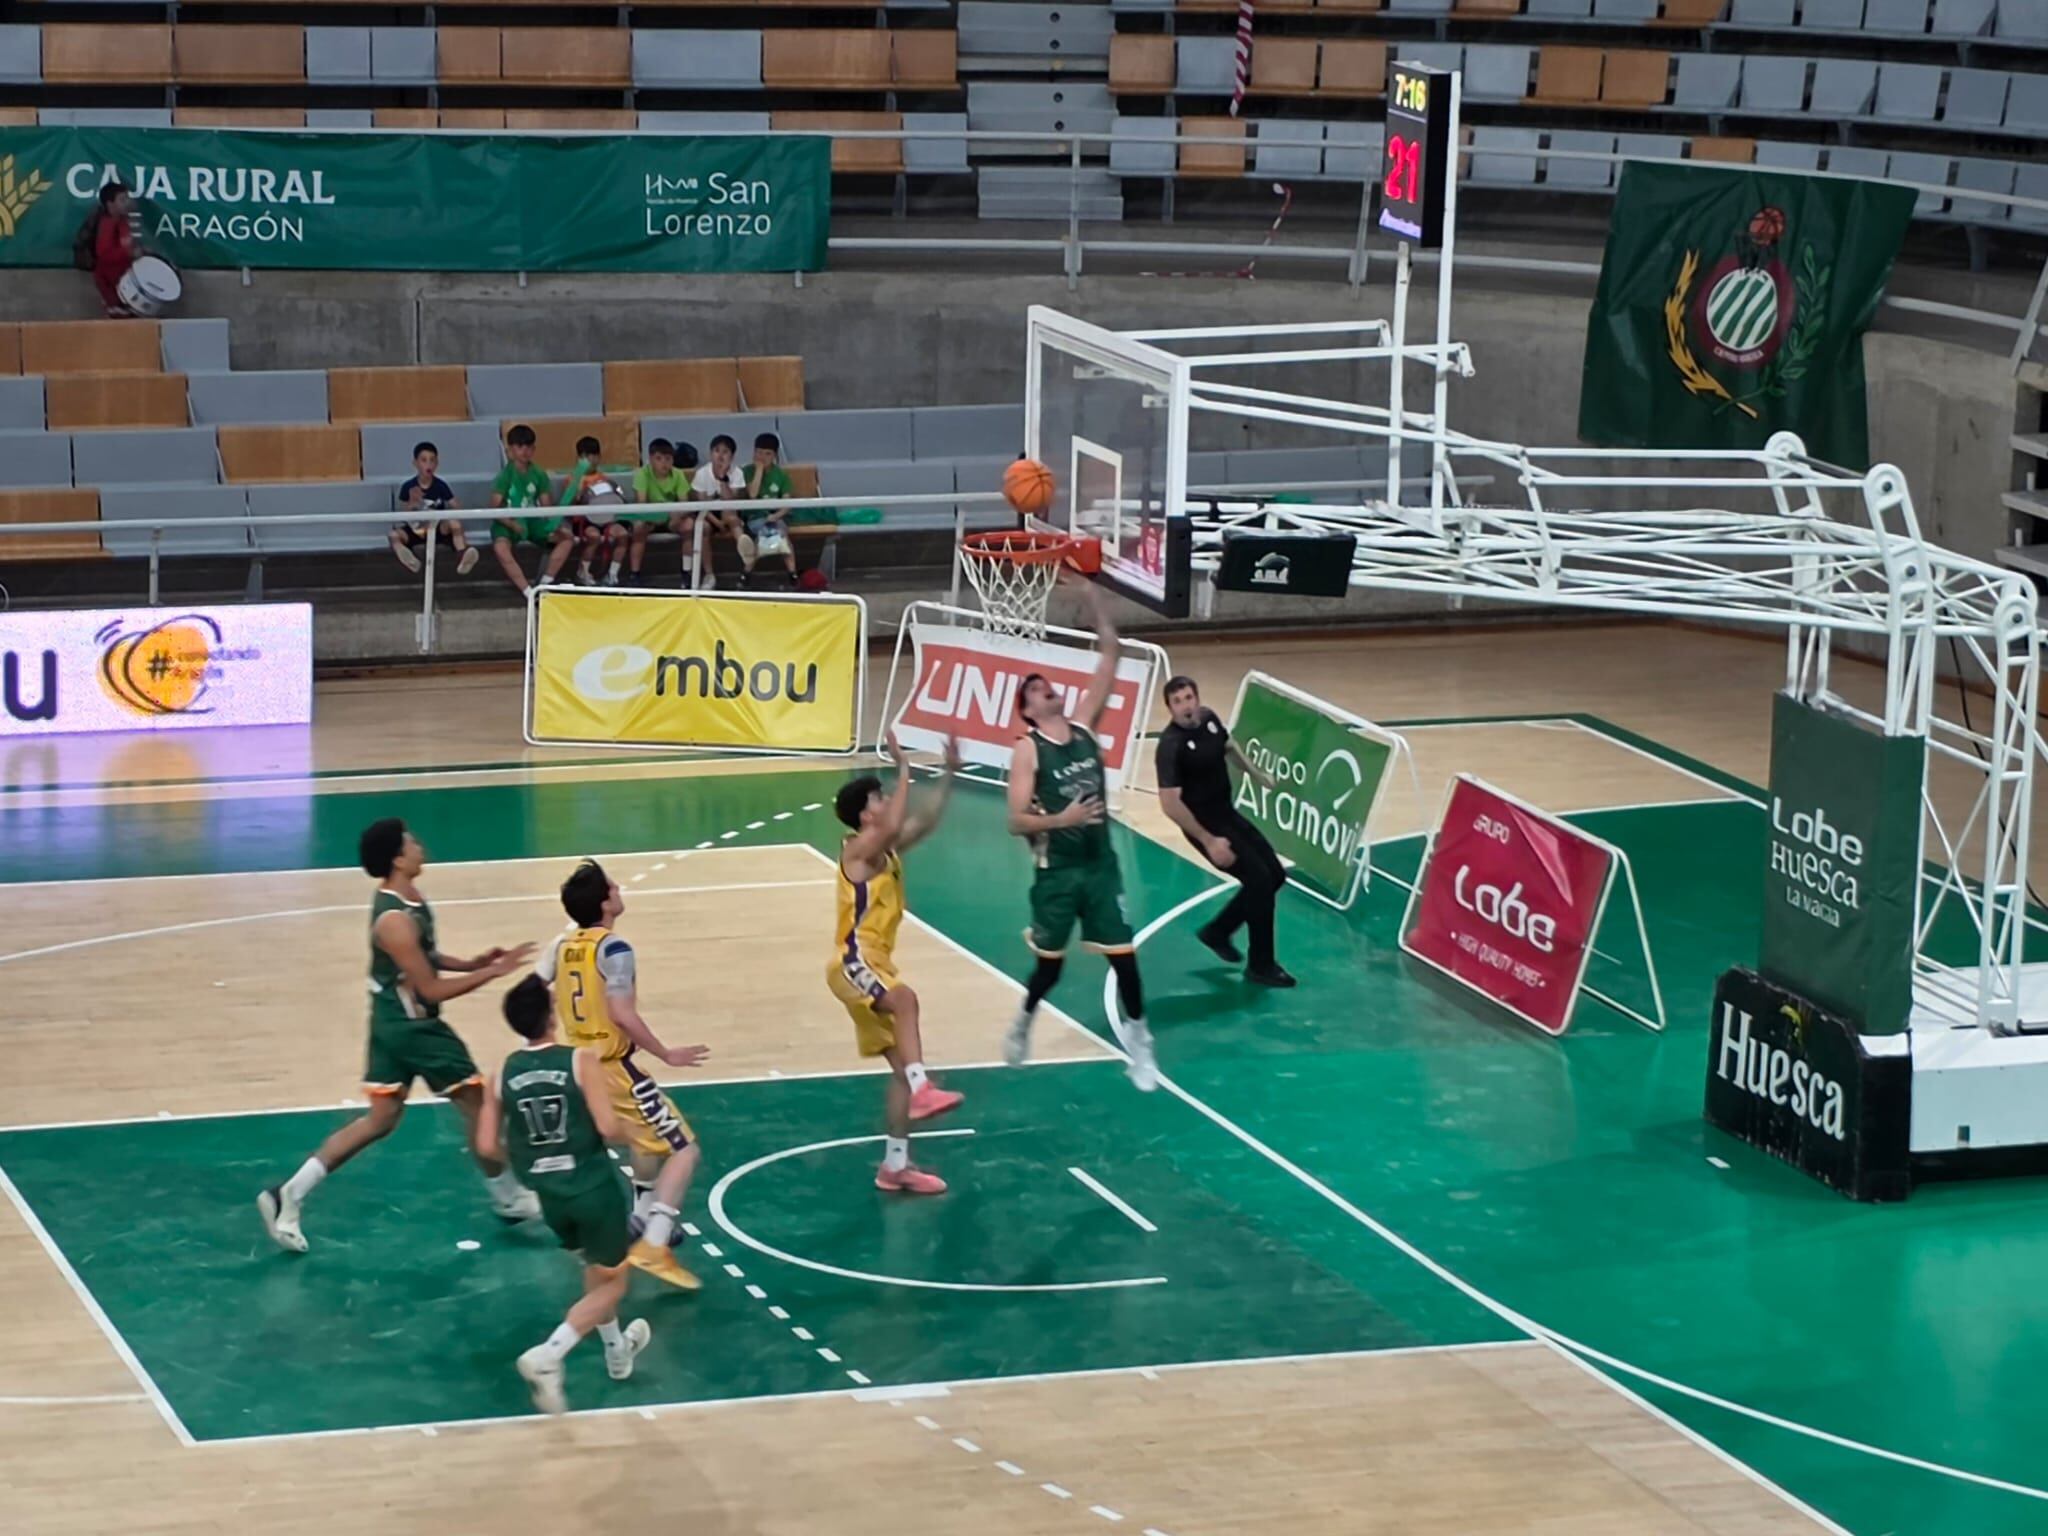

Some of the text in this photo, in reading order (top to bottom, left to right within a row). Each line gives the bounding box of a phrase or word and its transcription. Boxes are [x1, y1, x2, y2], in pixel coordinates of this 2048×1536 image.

[66, 163, 336, 204] CAJA RURAL
[708, 172, 771, 204] San
[1385, 135, 1420, 204] 21
[154, 210, 304, 242] ARAGÓN
[646, 207, 772, 236] Lorenzo
[571, 638, 818, 704] embou
[1245, 737, 1307, 785] Grupo
[1770, 796, 1863, 866] Lobe
[1454, 864, 1557, 953] Lobe
[568, 970, 586, 1022] 2
[1716, 1001, 1845, 1141] Huesca
